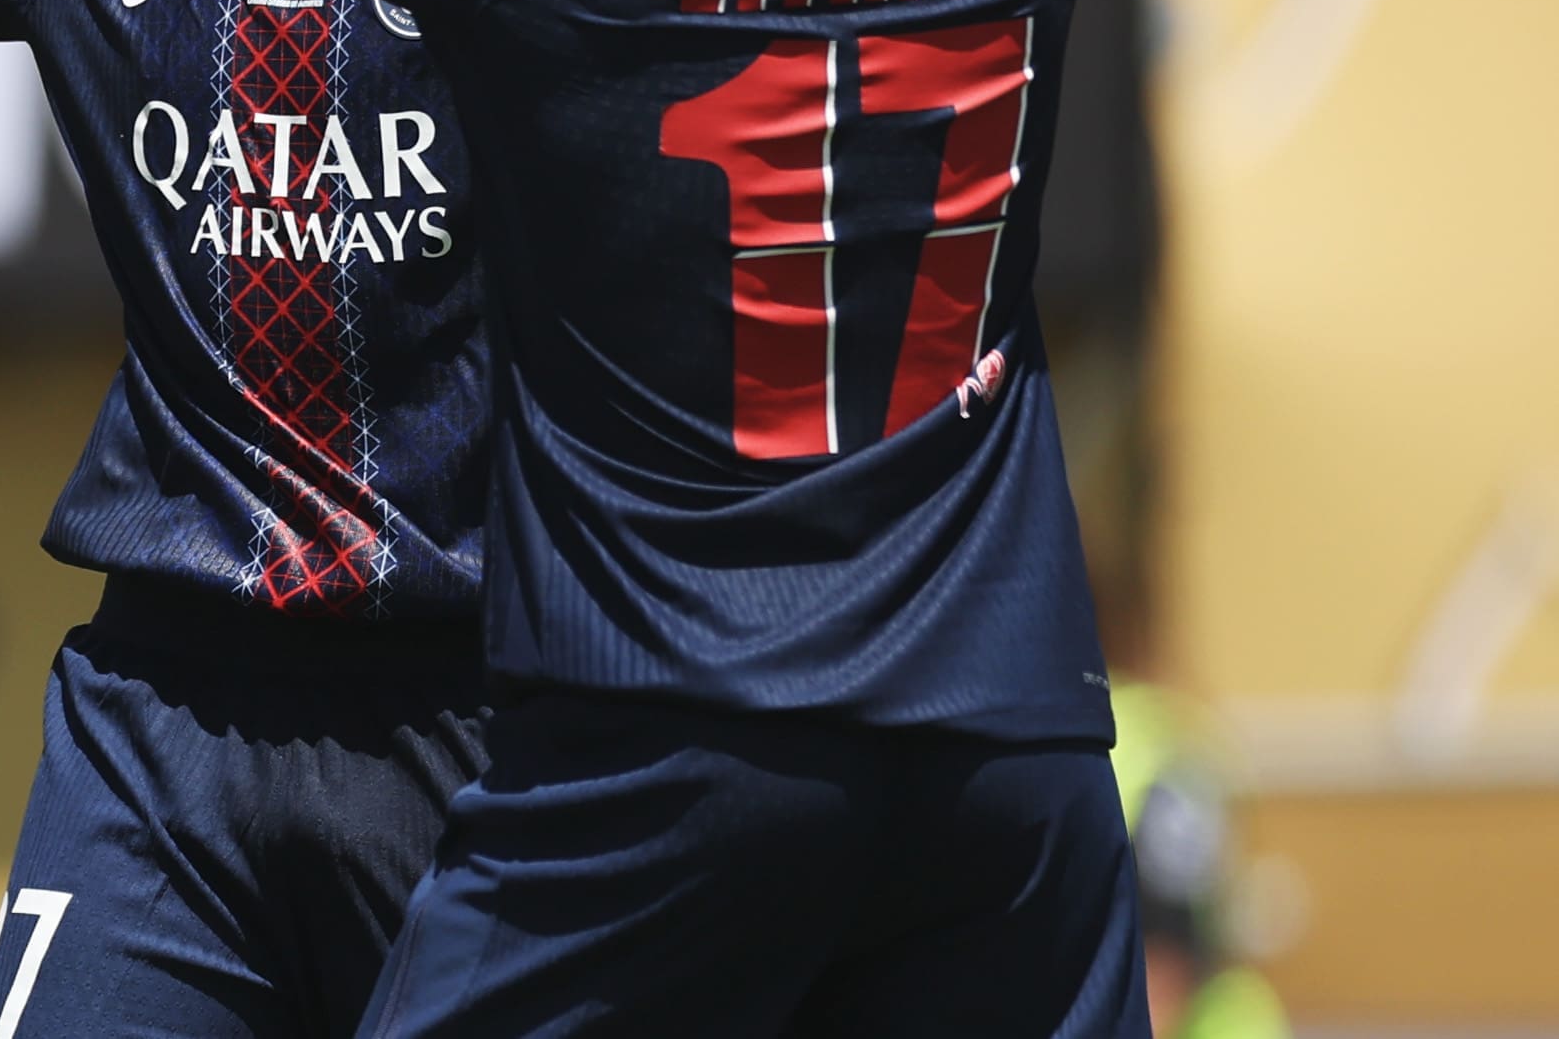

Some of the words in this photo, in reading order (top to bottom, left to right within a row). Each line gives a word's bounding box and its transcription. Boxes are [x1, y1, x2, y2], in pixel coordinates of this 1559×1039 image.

[132, 99, 447, 210] QATAR
[190, 203, 453, 263] AIRWAYS
[659, 16, 1035, 460] 17
